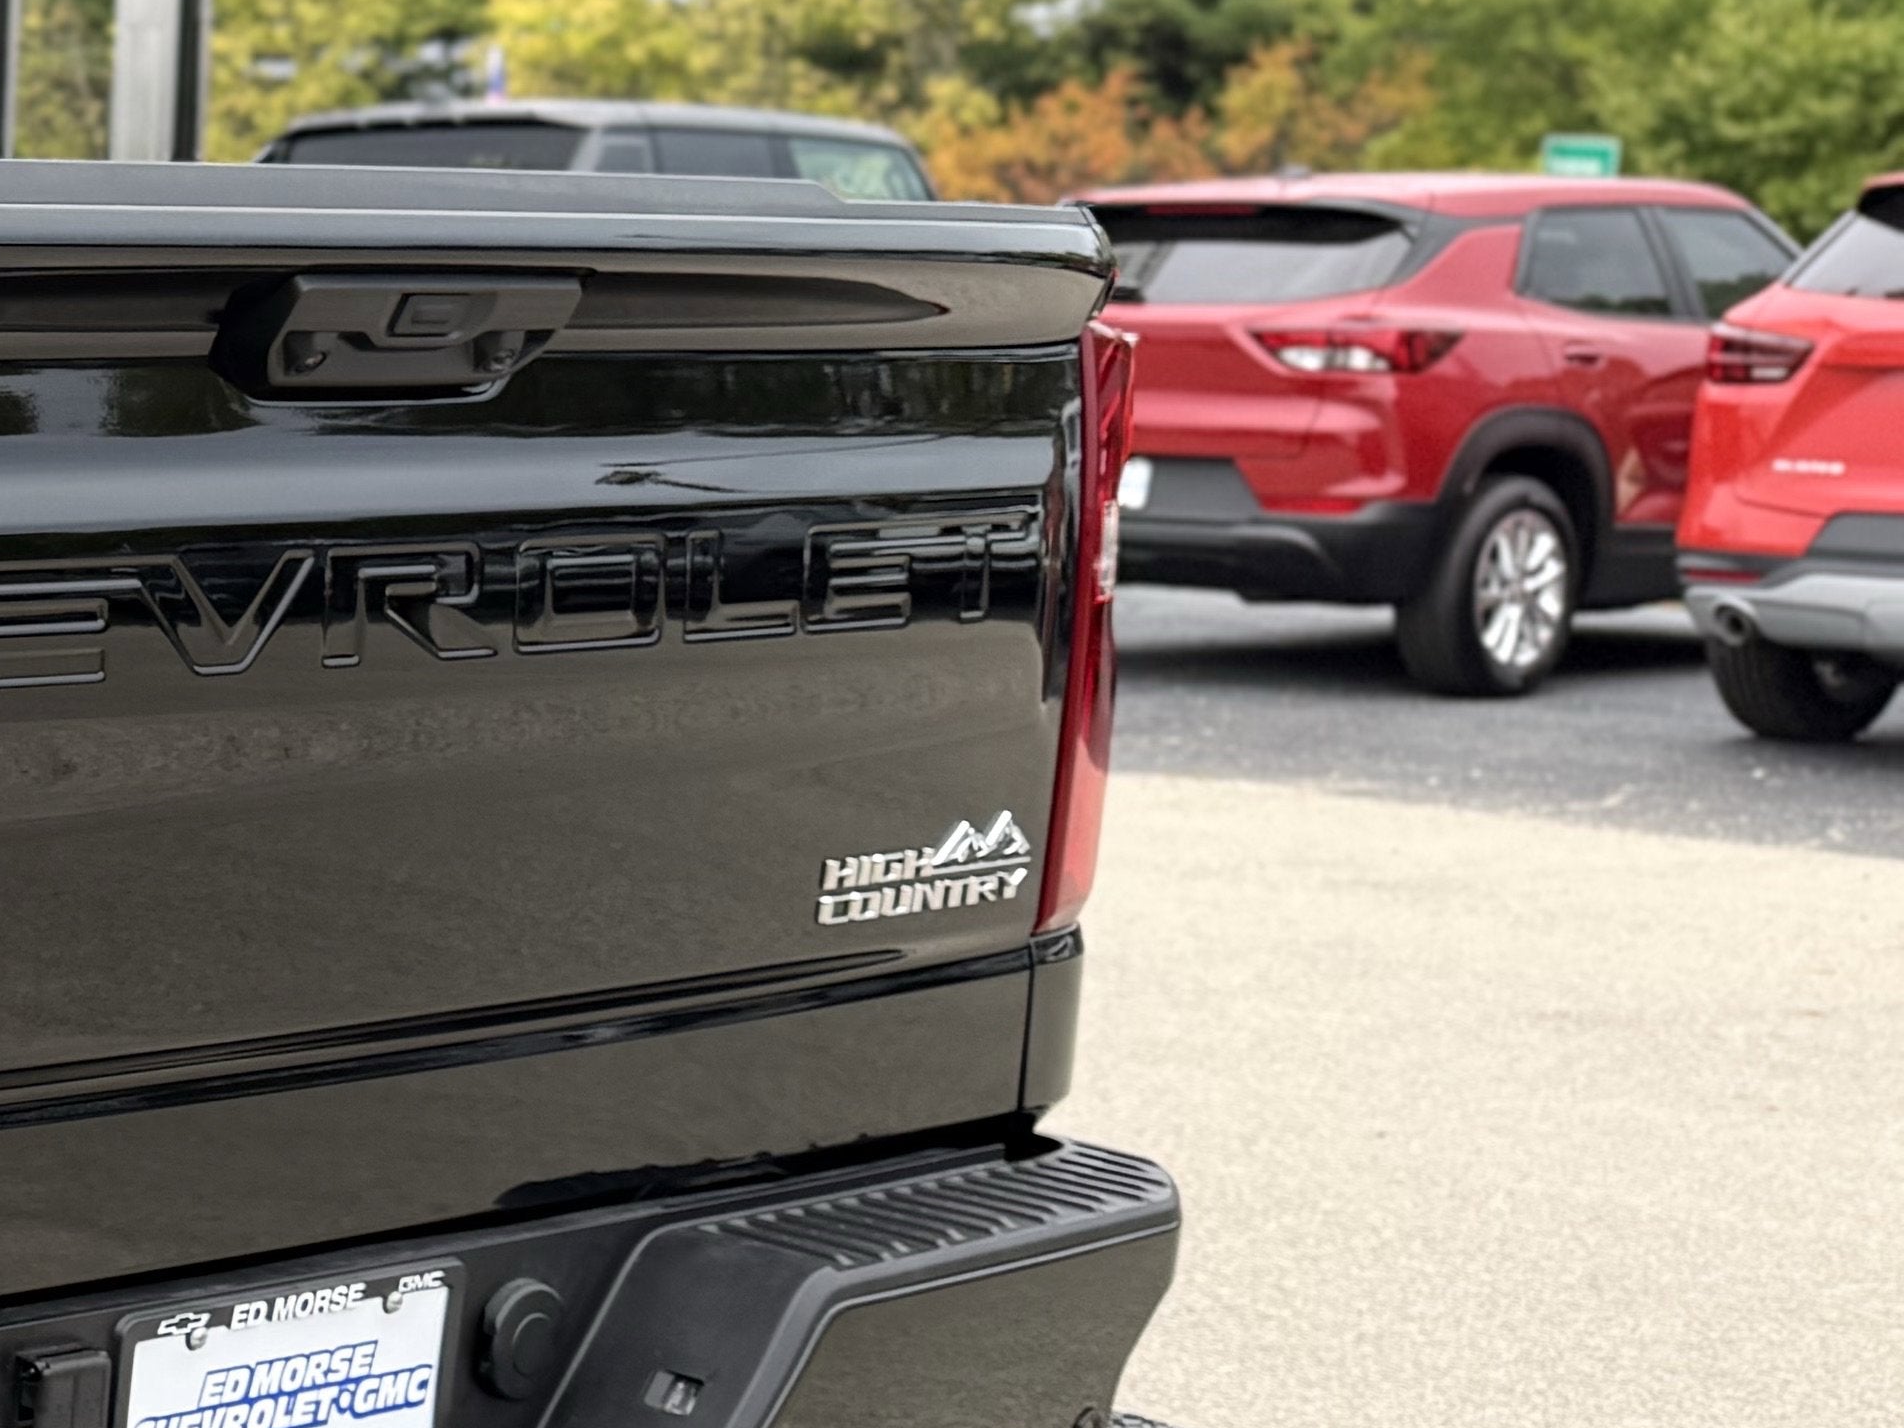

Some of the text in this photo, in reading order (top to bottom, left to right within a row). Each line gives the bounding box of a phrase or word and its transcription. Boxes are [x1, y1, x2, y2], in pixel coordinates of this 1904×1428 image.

[821, 846, 937, 891] HIGH
[817, 867, 1028, 925] COUNTRY
[398, 1270, 446, 1293] GMC
[230, 1282, 367, 1330] ED MORSE
[198, 1340, 378, 1409] ED MORSE
